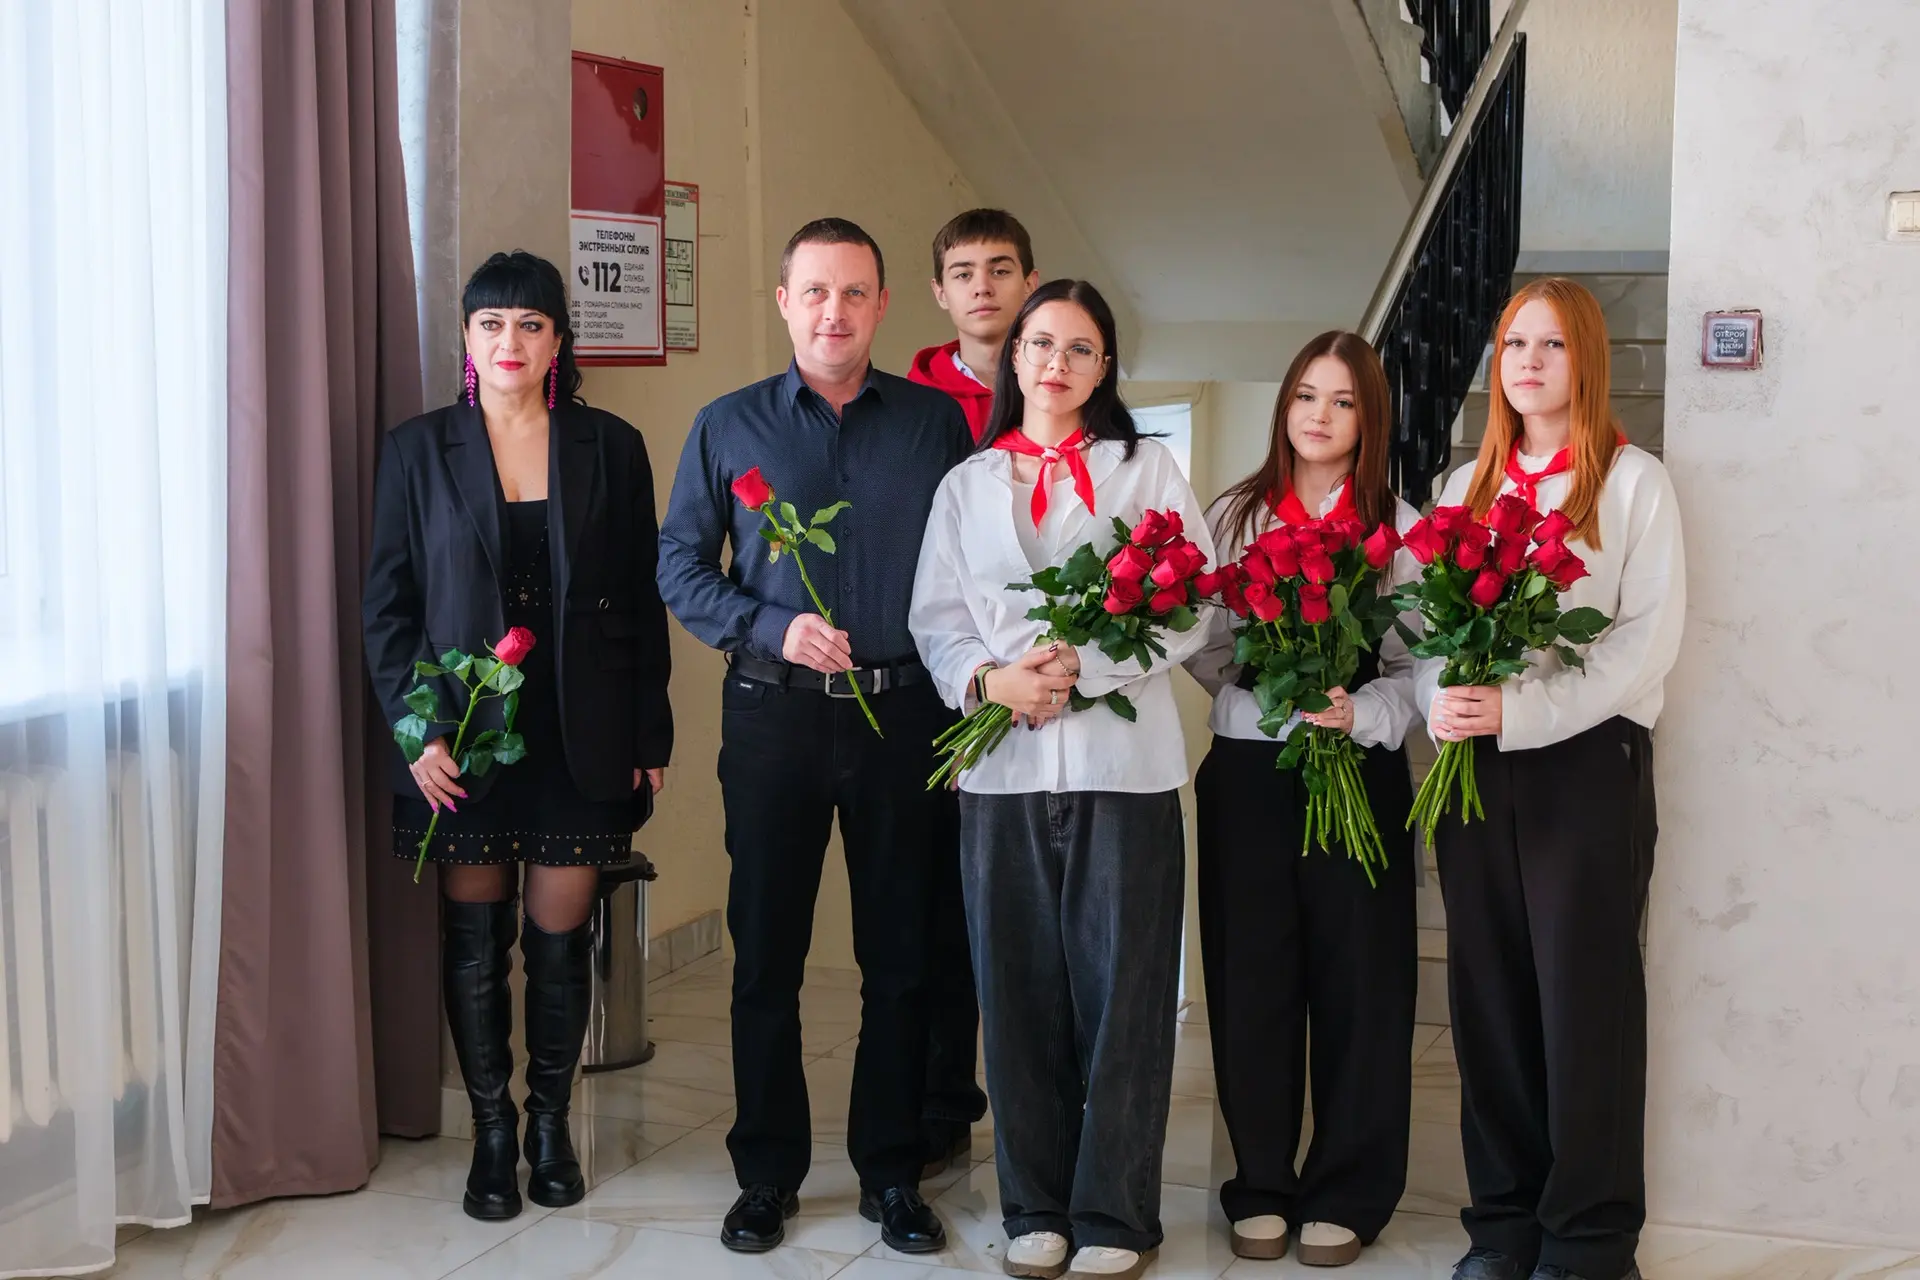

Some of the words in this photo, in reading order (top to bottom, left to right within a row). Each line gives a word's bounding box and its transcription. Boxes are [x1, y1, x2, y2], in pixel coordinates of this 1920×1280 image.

[596, 229, 635, 241] ТЕЛЕФОНЫ
[578, 241, 625, 254] ЭКСТРЕННЫХ
[627, 244, 650, 255] СЛУЖБ
[624, 262, 645, 271] ЕДИНАЯ
[593, 262, 621, 292] 112
[624, 274, 645, 282] СЛУЖБА
[624, 285, 650, 294] СПАСЕНИЯ
[584, 300, 610, 308] ПОЖАРНАЯ
[611, 301, 630, 309] СЛУЖБА
[584, 311, 607, 319] ПОЛИЦИЯ
[584, 321, 602, 329] СКОРАЯ
[603, 321, 625, 330] ПОМОЩЬ
[604, 332, 624, 340] СЛУЖБА
[1715, 330, 1745, 338] ОТКРОЙ
